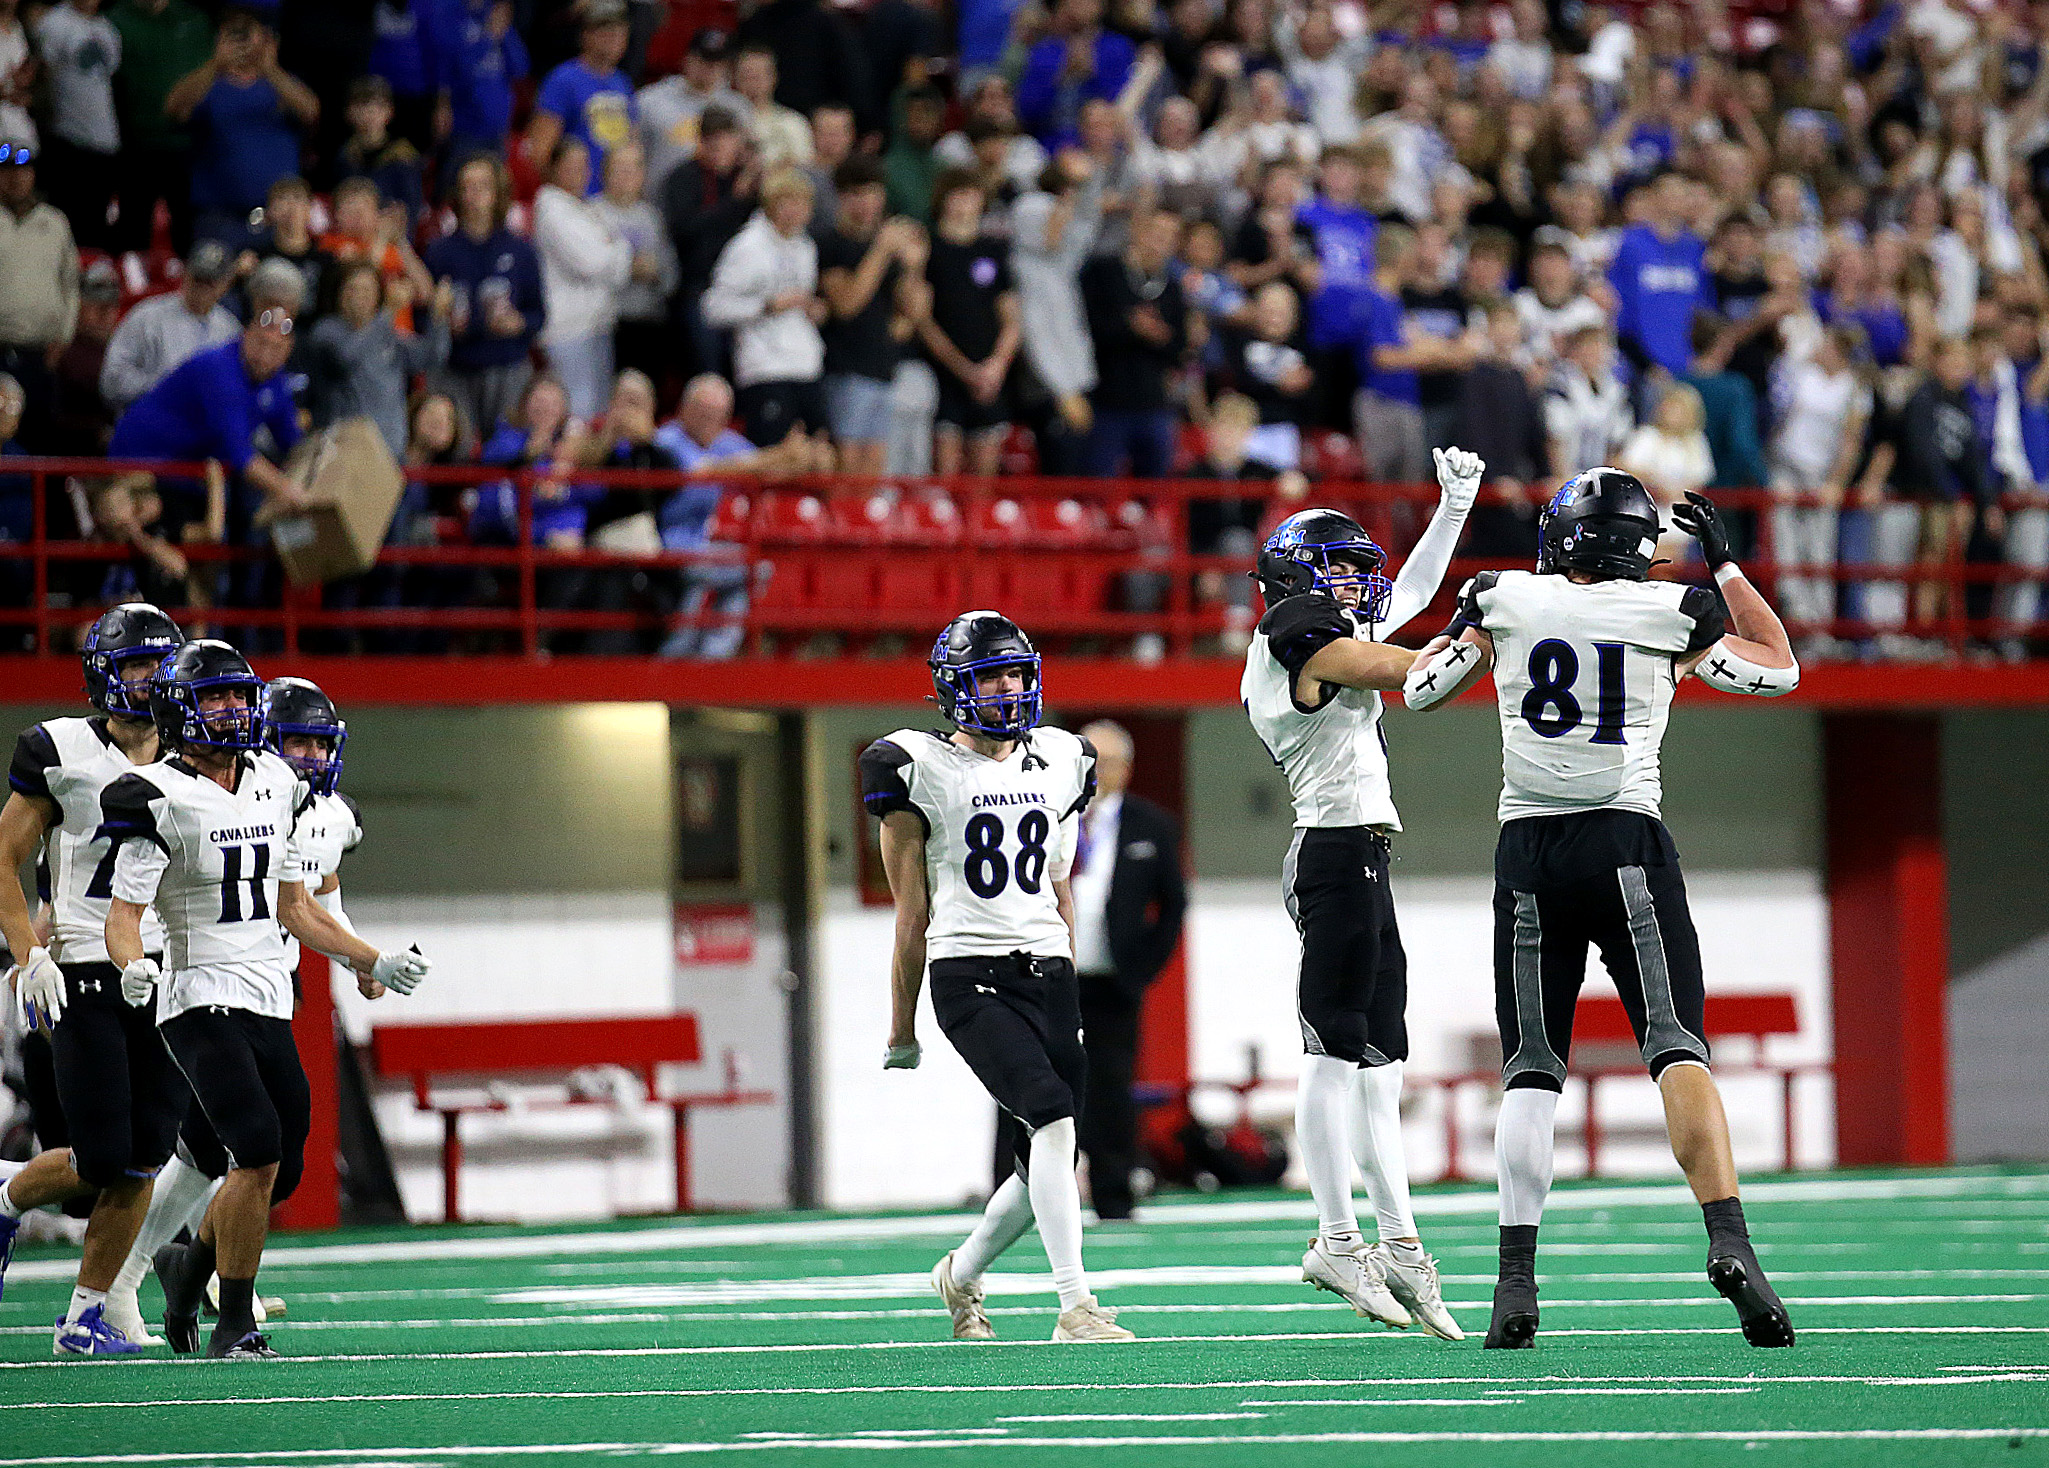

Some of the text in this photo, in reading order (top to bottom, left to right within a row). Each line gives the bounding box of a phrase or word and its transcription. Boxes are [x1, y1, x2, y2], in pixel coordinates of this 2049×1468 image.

[1521, 638, 1628, 745] 81
[210, 824, 275, 842] CAVALIERS
[971, 792, 1047, 808] CAVALIERS
[217, 842, 271, 923] 11
[964, 809, 1050, 899] 88
